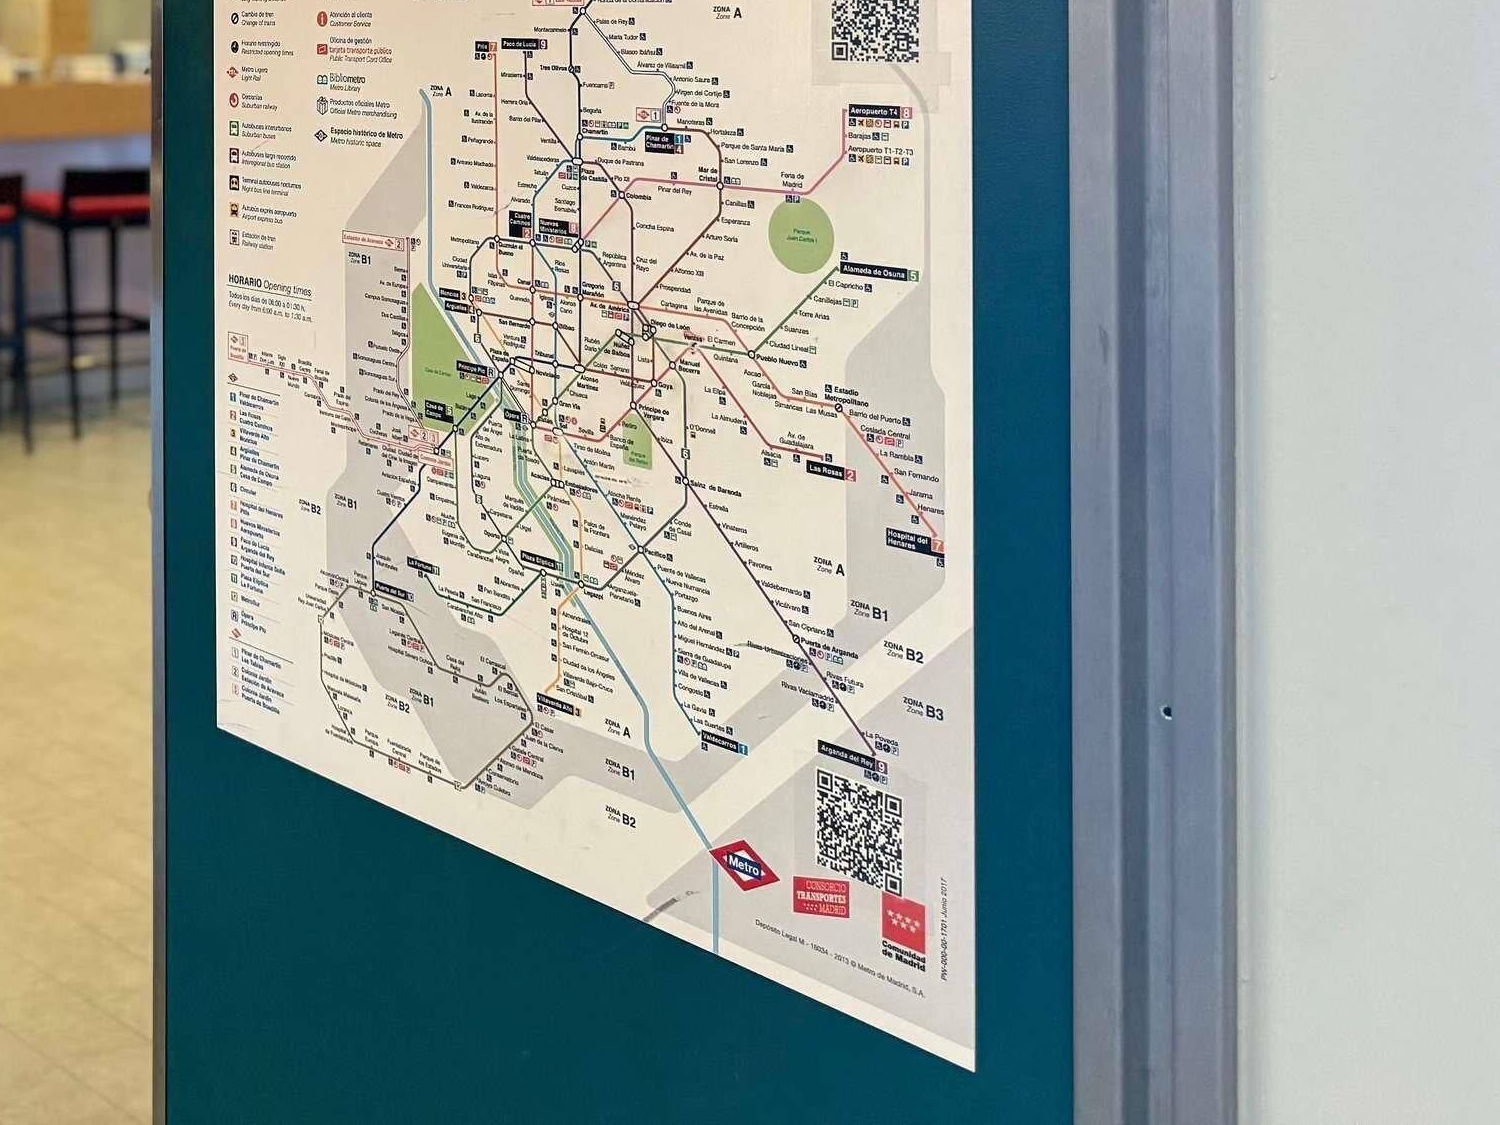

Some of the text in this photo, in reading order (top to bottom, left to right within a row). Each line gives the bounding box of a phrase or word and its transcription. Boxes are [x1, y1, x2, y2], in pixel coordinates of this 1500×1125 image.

[733, 7, 742, 18] A
[848, 132, 871, 141] Barajas
[848, 145, 914, 156] Aeropuerto T1-T2-T3
[842, 264, 870, 276] Alameda
[872, 268, 880, 276] de
[882, 269, 905, 280] Osuna
[229, 274, 262, 288] HORARIO
[834, 386, 859, 396] Estadio
[824, 467, 842, 477] Rosas
[846, 469, 855, 482] 2
[908, 470, 939, 483] Fernando
[888, 530, 916, 542] Hospital
[933, 538, 943, 554] 7
[814, 556, 845, 576] ZONA A
[850, 599, 888, 622] ZONA B1
[884, 640, 924, 664] ZONA B2
[903, 696, 944, 721] ZONA B3
[622, 766, 634, 780] B1
[622, 813, 636, 828] B2
[729, 855, 759, 876] Metro
[796, 891, 847, 904] TRANSPORTES
[818, 904, 846, 916] MADRID
[882, 940, 926, 964] Comunidad
[882, 949, 925, 972] de Madrid
